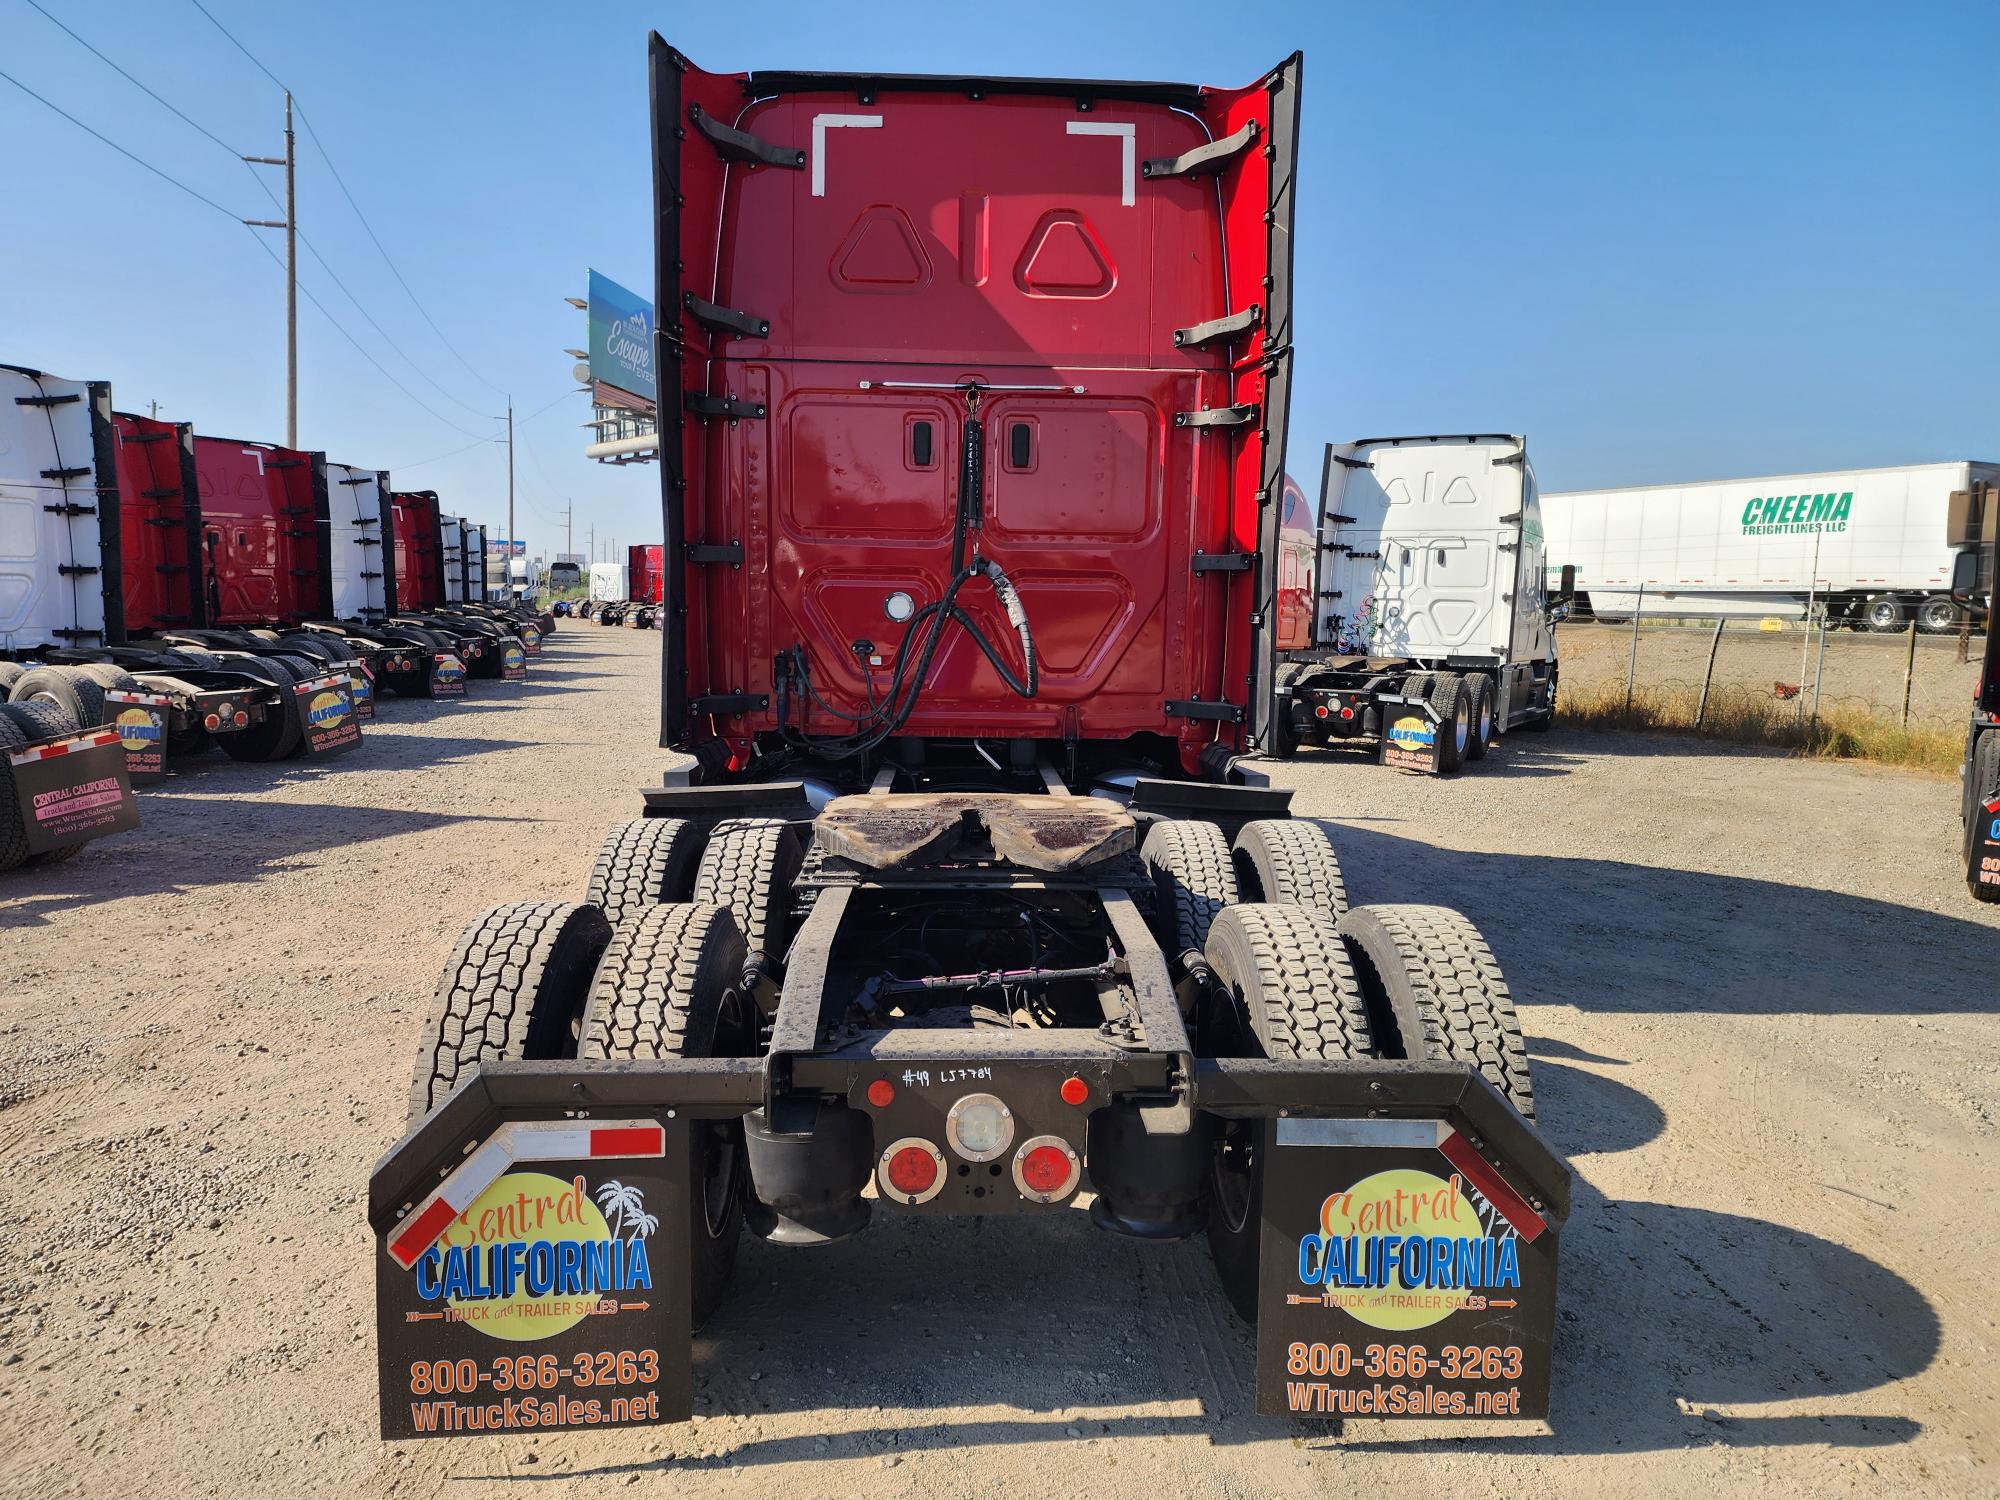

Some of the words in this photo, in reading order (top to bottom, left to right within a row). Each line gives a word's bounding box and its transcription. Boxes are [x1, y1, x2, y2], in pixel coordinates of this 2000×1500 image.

[607, 320, 650, 372] Escape
[1742, 492, 1853, 525] CHEEMA
[1742, 522, 1822, 536] FREIGHTLINES
[1825, 522, 1847, 532] LLC
[33, 788, 72, 808] CENTRAL
[72, 777, 120, 796] CALIFORNIA
[43, 806, 61, 816] Truck
[63, 802, 76, 812] and
[78, 798, 98, 808] Trailer
[100, 794, 117, 803] Sales
[53, 823, 77, 836] (800)
[79, 815, 115, 831] 366-3263
[902, 1068, 929, 1087] #49
[1319, 1173, 1462, 1239] Central
[416, 1238, 653, 1300] CALIFORNIA
[1299, 1233, 1521, 1289] CALIFORNIA
[443, 1306, 490, 1323] TRUCK
[494, 1301, 514, 1320] and
[516, 1302, 571, 1317] TRAILER
[575, 1300, 619, 1316] SALES
[1322, 1293, 1364, 1308] TRUCK
[1368, 1292, 1388, 1307] and
[1390, 1295, 1441, 1309] TRAILER
[1445, 1296, 1487, 1311] SALES
[410, 1349, 660, 1395] 800-366-3263
[1287, 1342, 1523, 1380] 800-366-3263
[410, 1390, 660, 1432] WTruckSales.net
[1286, 1381, 1521, 1414] WTruckSales.net
